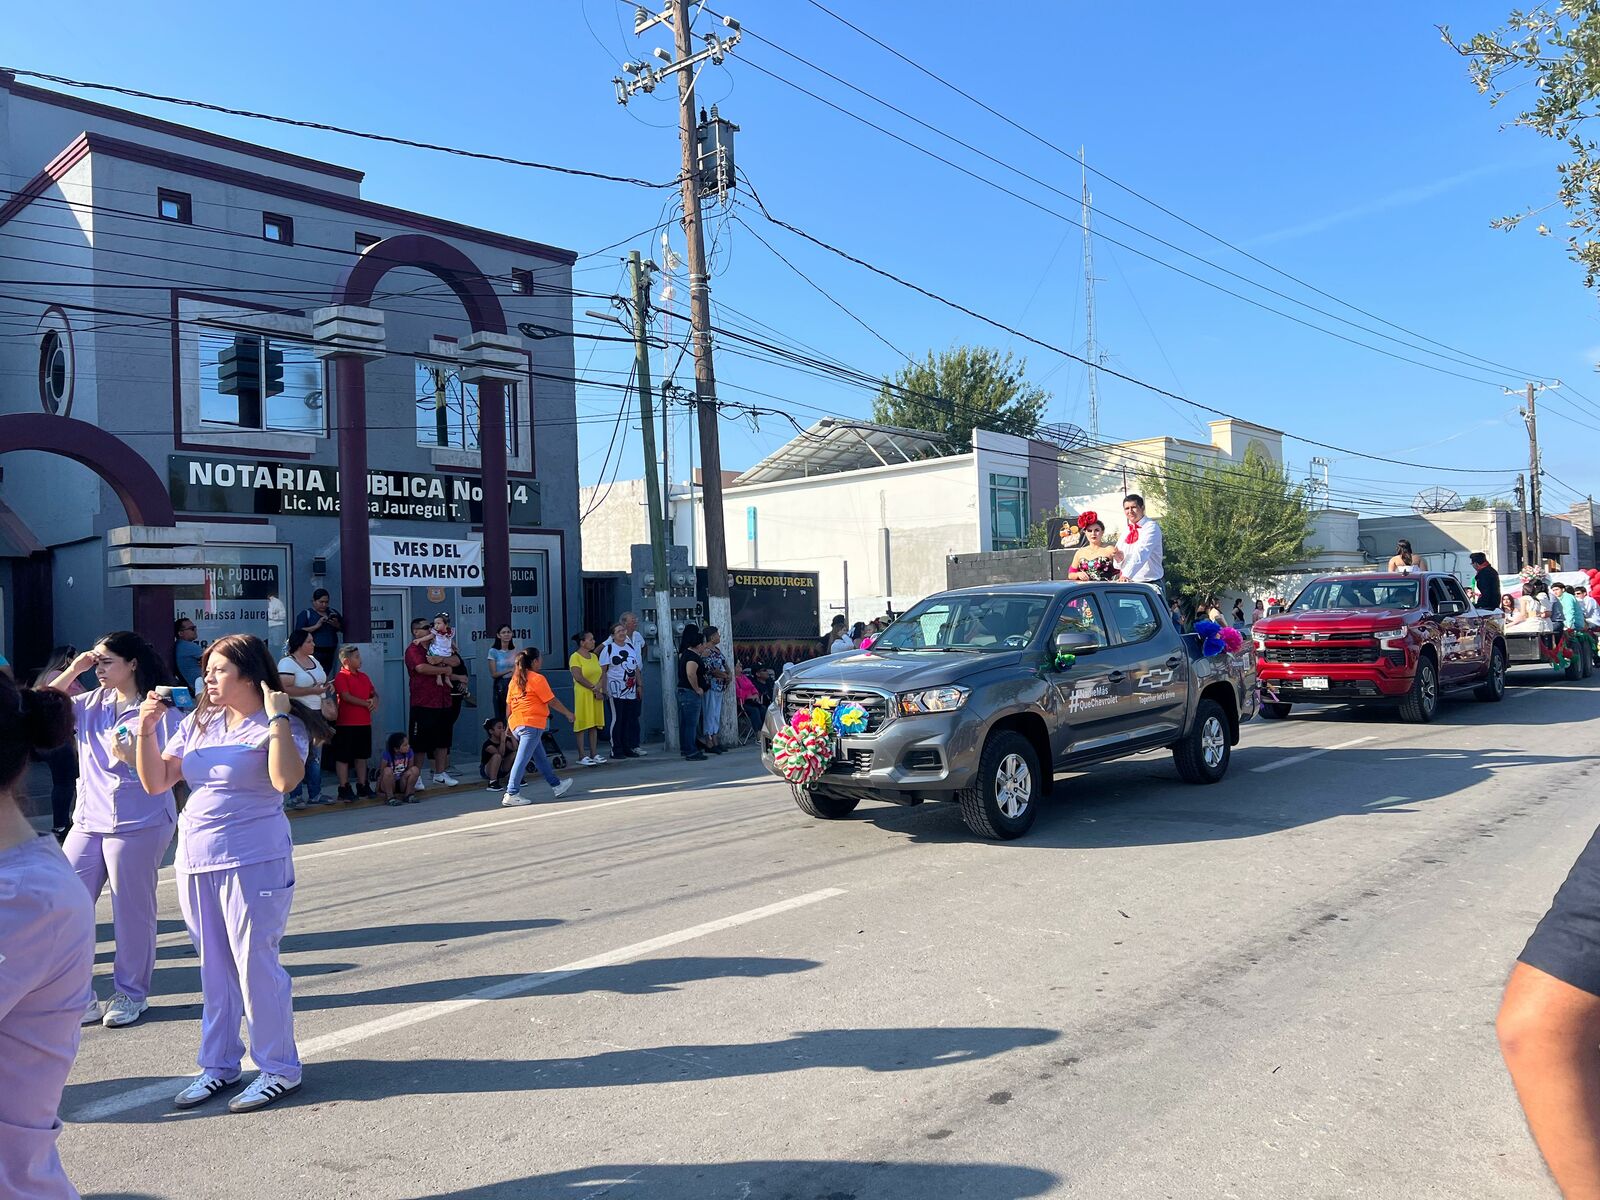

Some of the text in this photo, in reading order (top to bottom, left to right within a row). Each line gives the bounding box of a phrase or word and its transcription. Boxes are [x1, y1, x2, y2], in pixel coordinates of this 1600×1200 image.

[189, 461, 326, 492] NOTARIA
[336, 472, 445, 499] BLICA
[284, 494, 312, 510] Lic.
[383, 500, 446, 519] Jauregui
[449, 504, 461, 517] T.
[393, 541, 461, 558] MES DEL
[228, 568, 275, 581] PUBLICA
[372, 562, 480, 579] TESTAMENTO
[512, 570, 535, 581] BLICA
[735, 575, 814, 587] CHEKOBURGER
[232, 584, 244, 596] 14
[461, 604, 476, 615] Lic.
